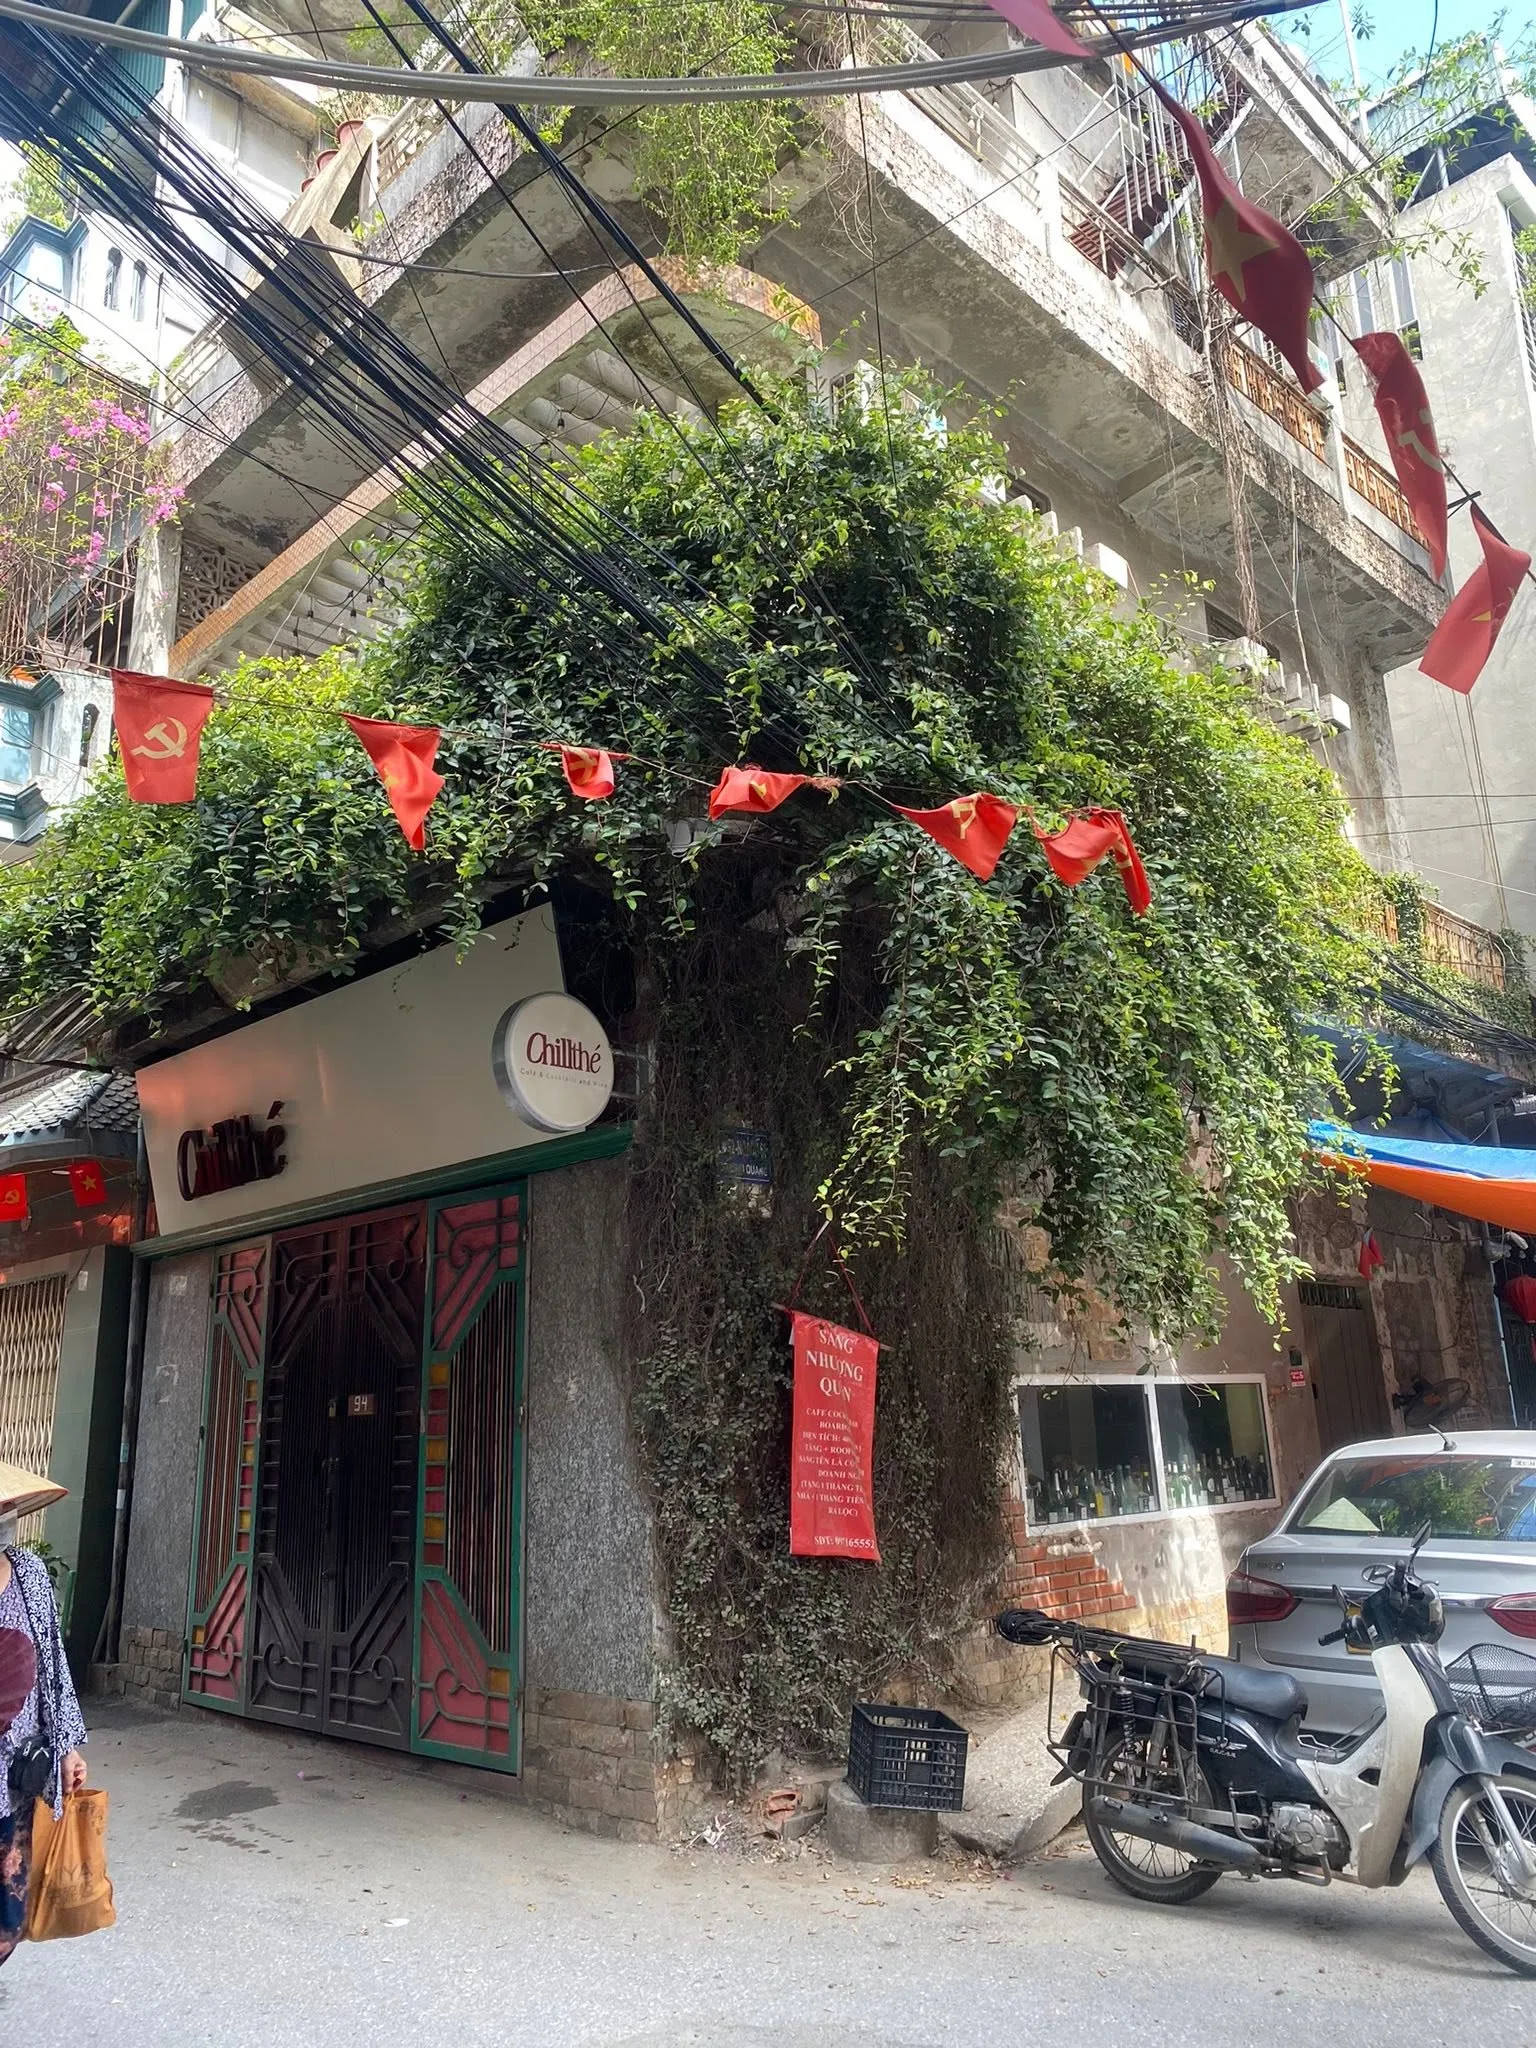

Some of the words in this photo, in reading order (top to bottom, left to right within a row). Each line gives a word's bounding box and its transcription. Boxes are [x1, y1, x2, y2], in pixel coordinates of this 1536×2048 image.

[526, 1032, 601, 1074] Chillthé
[820, 1329, 853, 1354] SANG
[354, 1395, 367, 1411] 94
